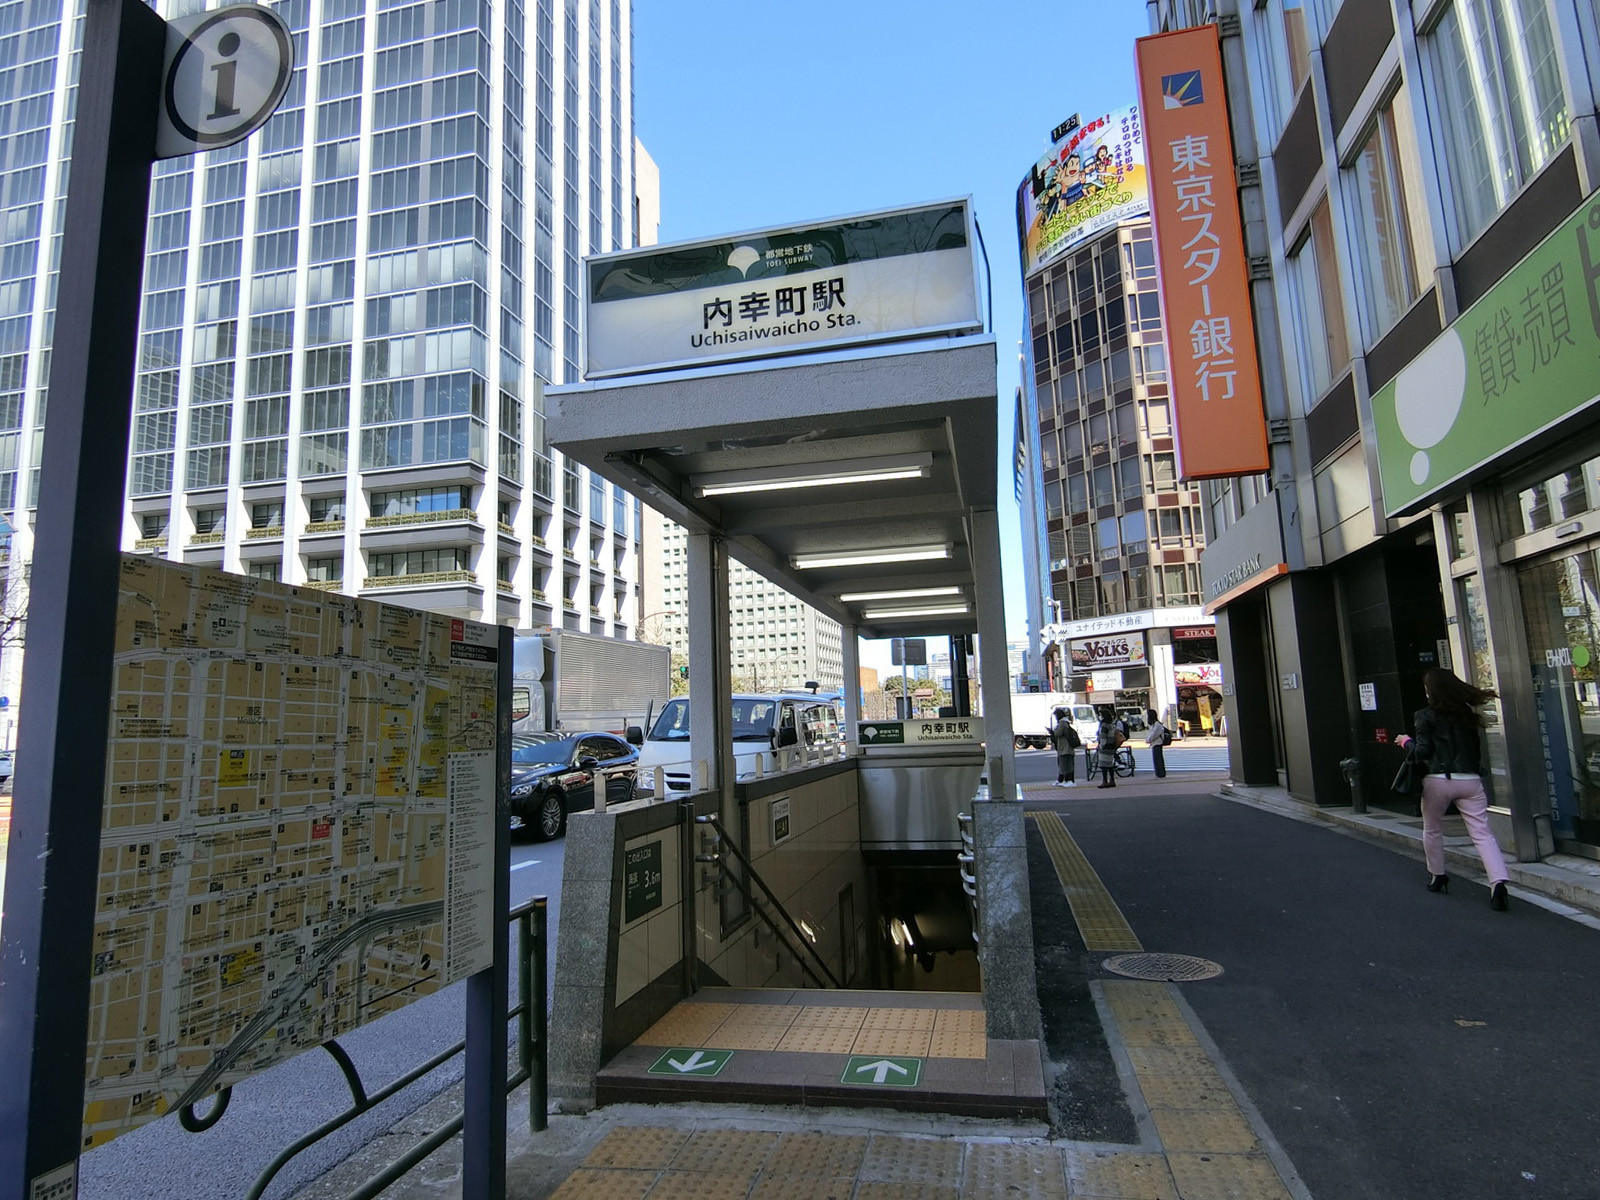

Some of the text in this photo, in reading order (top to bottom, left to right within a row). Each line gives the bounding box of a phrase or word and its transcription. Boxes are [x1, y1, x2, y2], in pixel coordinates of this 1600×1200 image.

[1052, 115, 1077, 139] 11:25
[765, 243, 814, 260] 都営地下鉄
[765, 254, 814, 268] TOEI SUBWAY
[1168, 134, 1238, 401] 東京スター銀行
[702, 276, 846, 330] 内幸町駅
[690, 310, 861, 349] Uchisaiwaicho Sta.
[1211, 552, 1262, 597] TOKYO STAR BANK
[1075, 616, 1143, 633] ユナイテッド不動産
[1184, 629, 1211, 637] STEAK
[1084, 641, 1130, 661] VOLKS
[917, 733, 962, 741] Uchisaiwaicho
[921, 721, 970, 735] 内幸町駅
